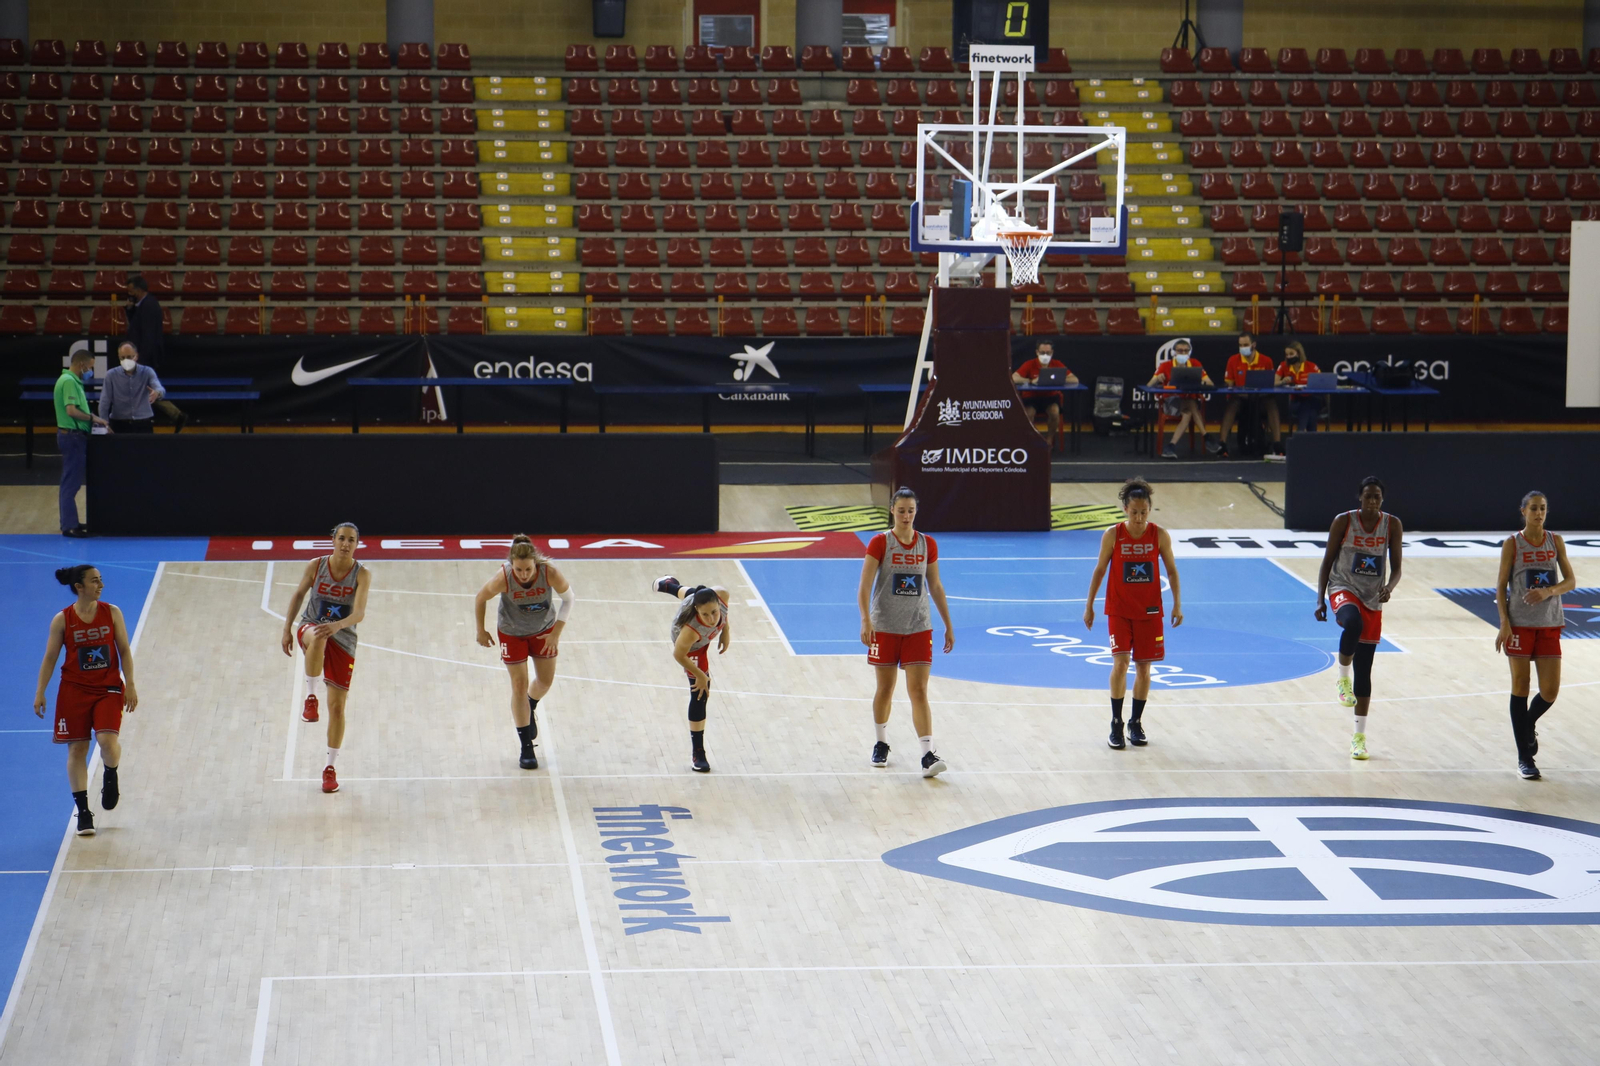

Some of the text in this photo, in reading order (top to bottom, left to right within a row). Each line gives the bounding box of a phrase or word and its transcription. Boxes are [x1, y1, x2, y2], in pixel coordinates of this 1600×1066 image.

[1004, 2, 1029, 37] 0
[971, 52, 1032, 64] finetwork
[473, 355, 593, 382] endesa
[962, 399, 1012, 410] AYUNTAMIENTO
[962, 411, 971, 420] DE
[945, 448, 1029, 465] IMDECO
[944, 466, 970, 474] Municipal
[978, 466, 1003, 474] Deportes
[1353, 535, 1386, 548] ESP
[1121, 543, 1154, 555] ESP
[891, 552, 925, 565] ESP
[1522, 550, 1556, 563] ESP
[317, 582, 354, 598] ESP
[513, 587, 546, 599] ESP
[73, 625, 111, 643] ESP
[82, 661, 108, 670] CaixaBank
[592, 804, 732, 936] finetwork
